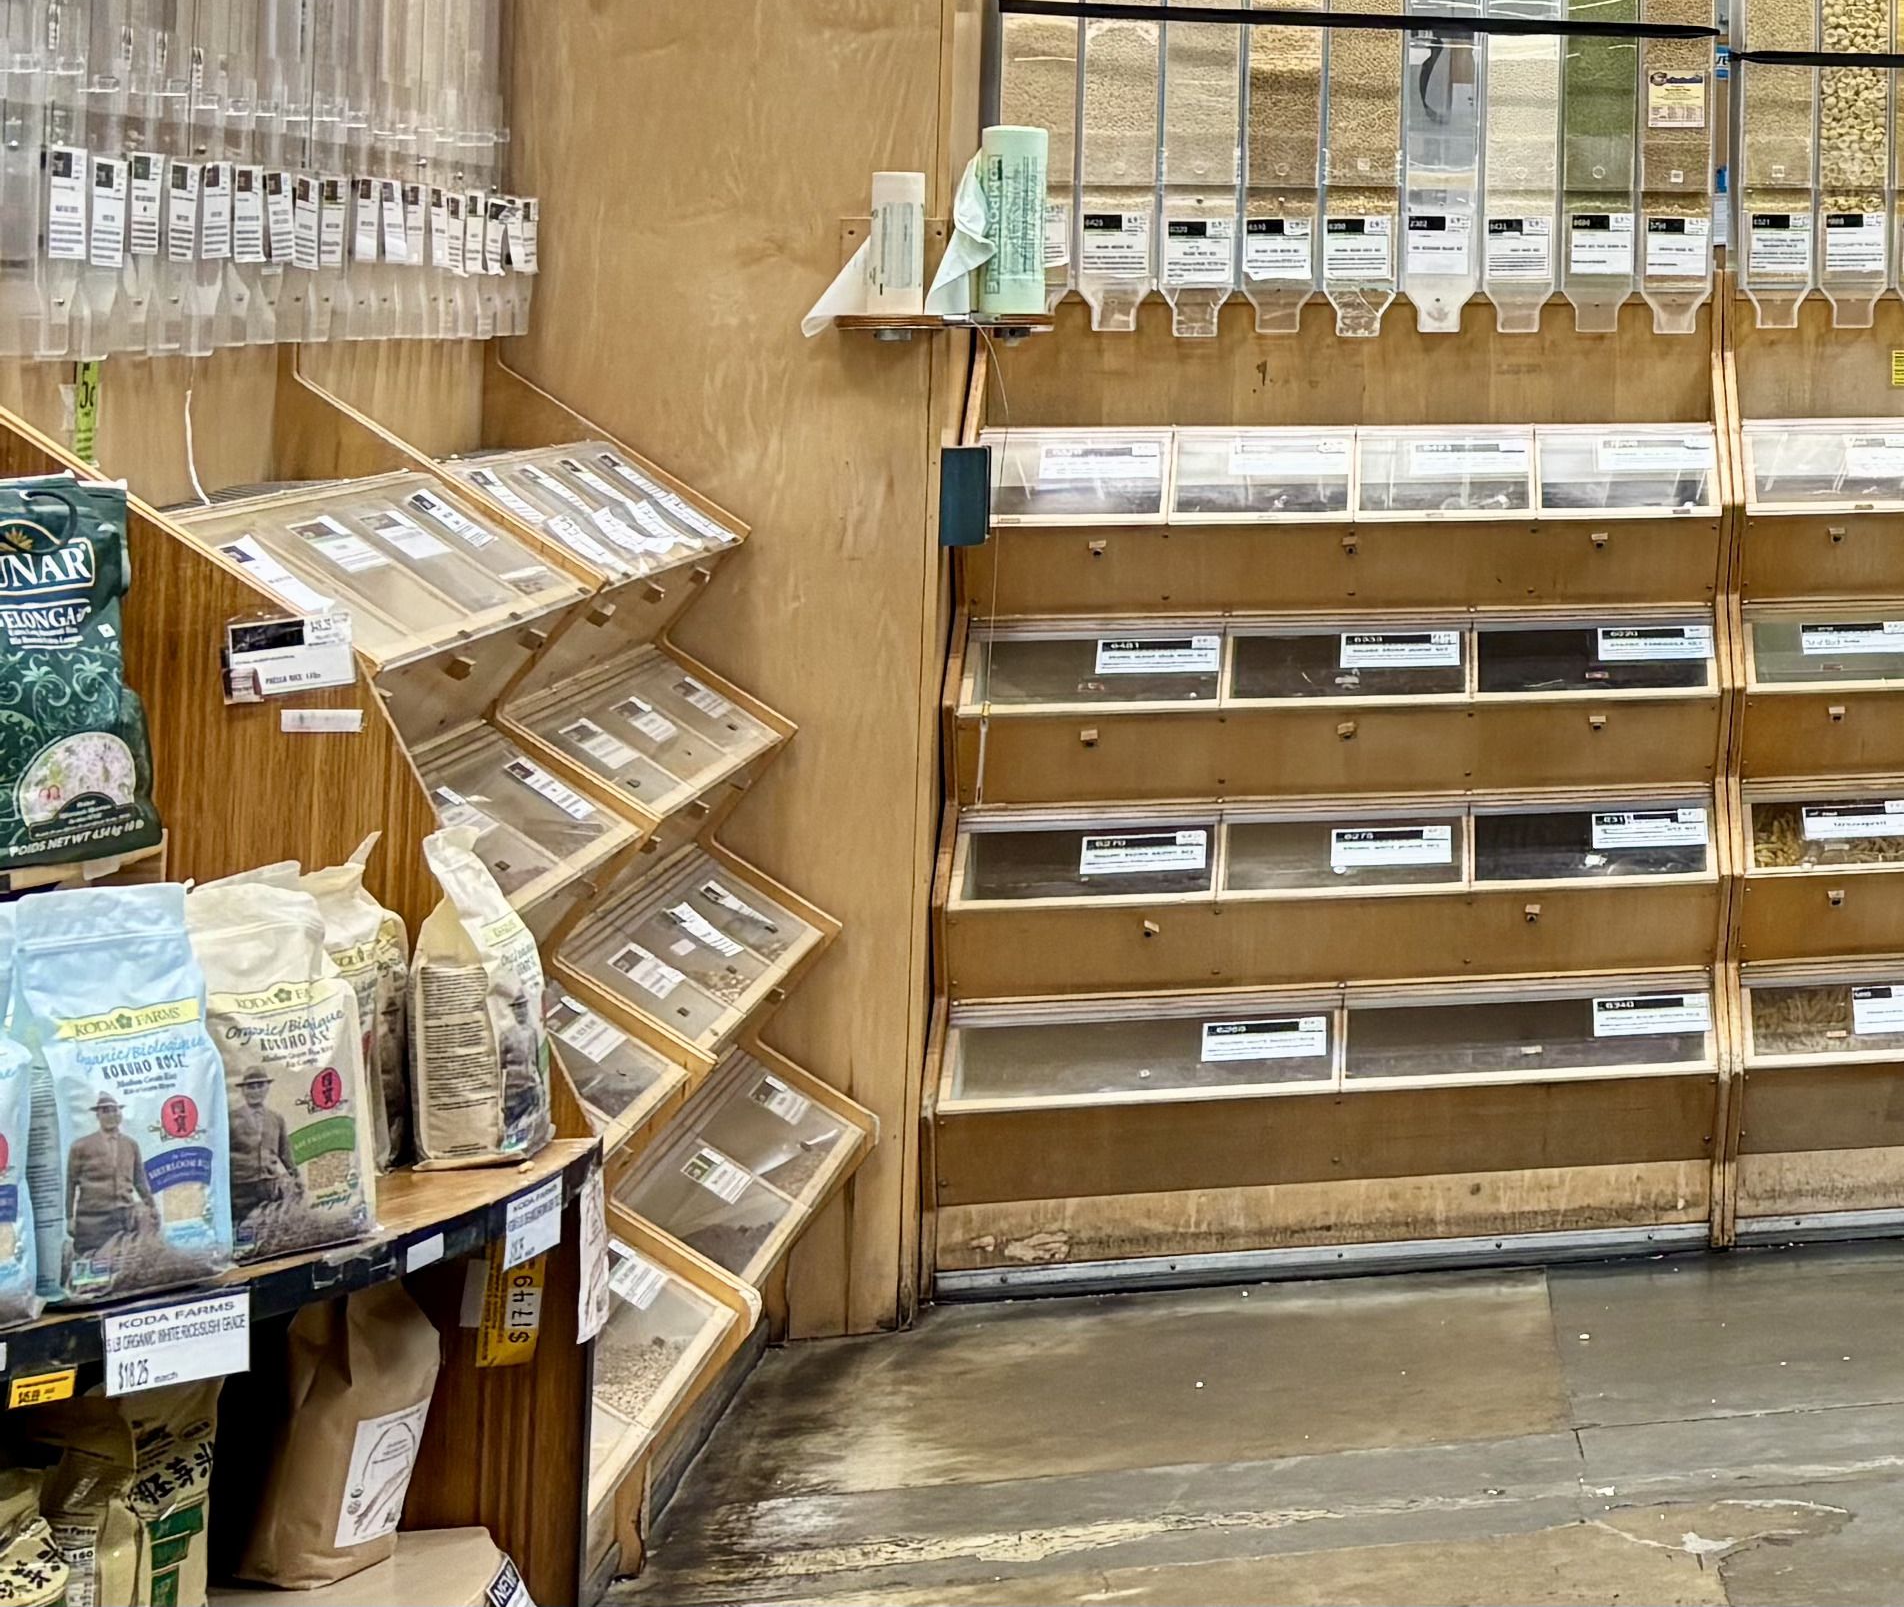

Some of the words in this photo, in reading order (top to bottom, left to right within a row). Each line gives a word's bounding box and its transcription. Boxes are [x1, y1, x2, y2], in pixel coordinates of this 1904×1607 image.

[9, 841, 46, 857] POIDS
[47, 836, 72, 850] NET
[71, 831, 92, 844] WT
[235, 997, 275, 1011] KODA
[74, 1020, 116, 1037] KODA
[136, 1007, 181, 1027] FARMS
[101, 1060, 151, 1081] KOKUHO
[155, 1053, 187, 1071] ROSE
[118, 1314, 169, 1330] KODA
[175, 1301, 235, 1320] FARMS
[507, 1274, 535, 1344] $17.49
[122, 1329, 157, 1350] ORGANIC
[157, 1325, 182, 1344] WHITE
[222, 1314, 246, 1331] GRADE
[153, 1371, 179, 1384] each
